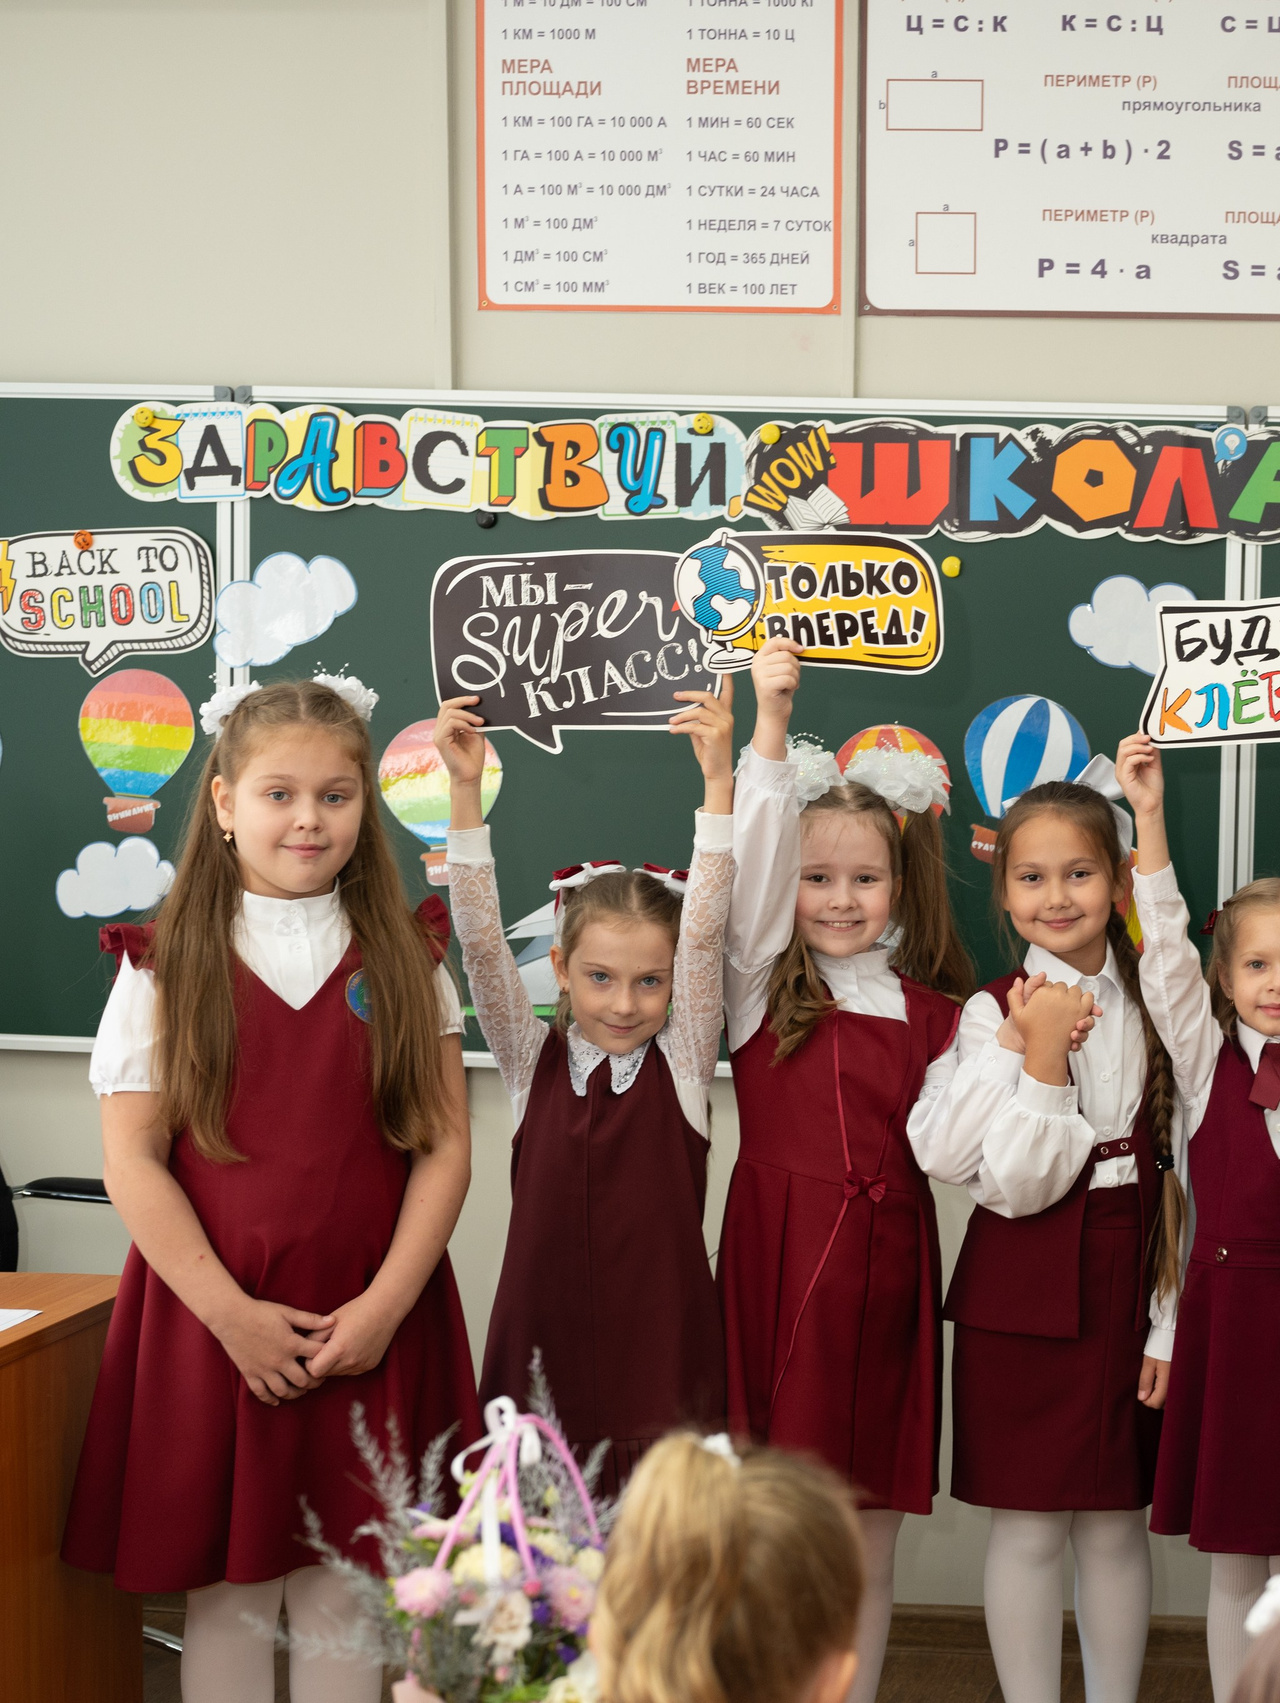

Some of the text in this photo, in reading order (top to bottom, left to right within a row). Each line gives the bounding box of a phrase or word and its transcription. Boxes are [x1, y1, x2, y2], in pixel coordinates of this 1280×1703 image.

[687, 29, 692, 39] 1
[698, 29, 748, 40] ТОННА
[766, 29, 780, 40] 10
[785, 29, 795, 42] Ц
[502, 59, 553, 73] МЕРА
[687, 58, 738, 72] МЕРА
[687, 80, 779, 95] ВРЕМЕНИ
[1045, 75, 1131, 87] ПЕРИМЕТР
[502, 81, 601, 98] ПЛОЩАДИ
[1122, 101, 1261, 114] прямоугольника
[687, 185, 691, 196] 1
[698, 185, 743, 196] СУТКИ
[761, 186, 775, 197] 24
[781, 186, 819, 197] ЧАСА
[1043, 209, 1129, 222] ПЕРИМЕТР
[687, 219, 691, 230] 1
[698, 220, 756, 232] НЕДЕЛЯ
[774, 220, 780, 231] 7
[786, 220, 831, 231] СУТОК
[1152, 234, 1227, 247] квадрата
[687, 283, 691, 293] 1
[698, 283, 725, 294] ВЕК
[743, 284, 765, 294] 100
[770, 284, 797, 295] ЛЕТ
[127, 412, 729, 516] ЗДРАВСТВУЙ
[745, 425, 838, 513] WOW!
[27, 545, 180, 578] BACK TO
[767, 560, 919, 601] ТОЛЬКО
[21, 579, 190, 631] SCHOOL
[767, 609, 928, 648] ВПЕРЕД!
[527, 645, 703, 719] КЛАСС!
